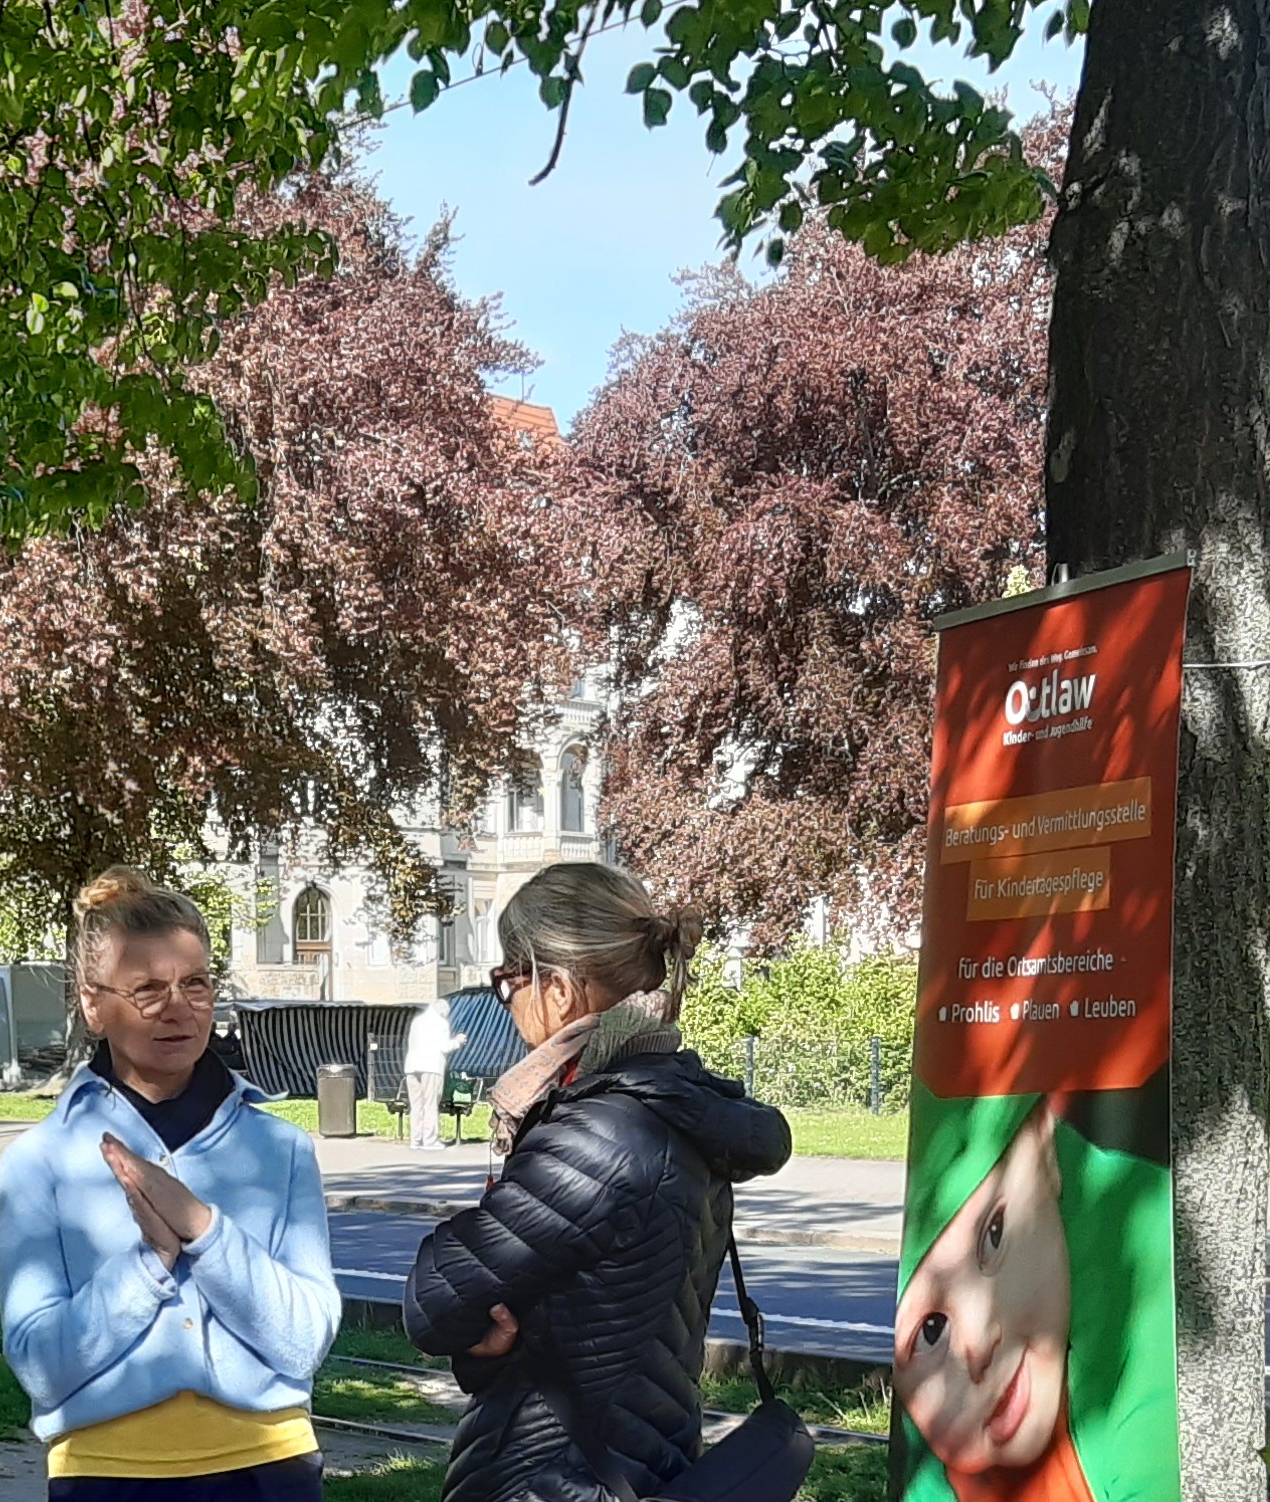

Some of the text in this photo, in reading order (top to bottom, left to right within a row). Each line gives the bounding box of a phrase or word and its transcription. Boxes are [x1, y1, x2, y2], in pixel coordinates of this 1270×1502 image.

[1004, 669, 1096, 725] Outlaw
[1003, 730, 1034, 746] Kinder-
[945, 799, 1146, 848] Beratungs- und Vermittlungsstelle
[997, 867, 1104, 898] Kindertagespflege
[958, 947, 1114, 979] für die Ortsamtsbereiche
[951, 994, 1136, 1023] Prohlis Plauen Leuben
